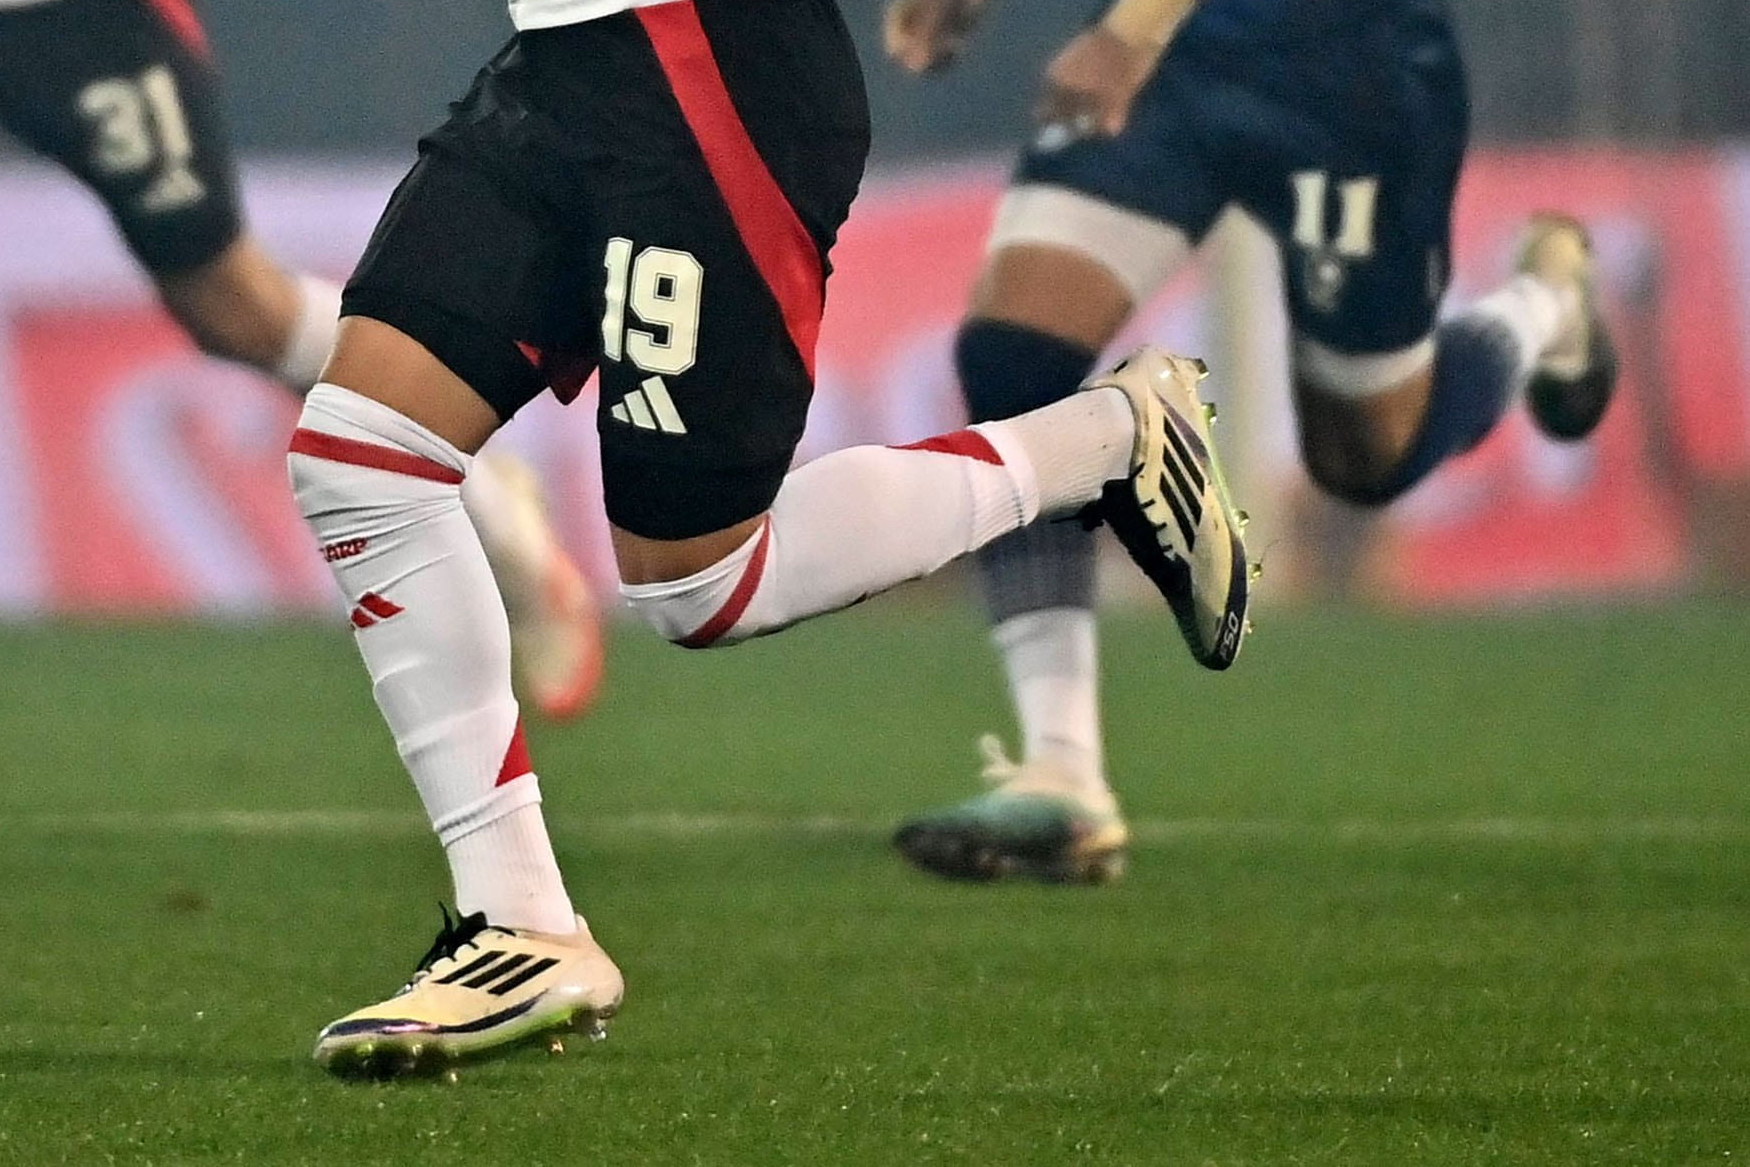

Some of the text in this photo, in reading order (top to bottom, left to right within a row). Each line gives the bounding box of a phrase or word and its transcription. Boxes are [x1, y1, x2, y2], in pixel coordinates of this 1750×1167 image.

[76, 64, 192, 170] 31
[1290, 168, 1379, 258] 11
[601, 236, 704, 375] 19
